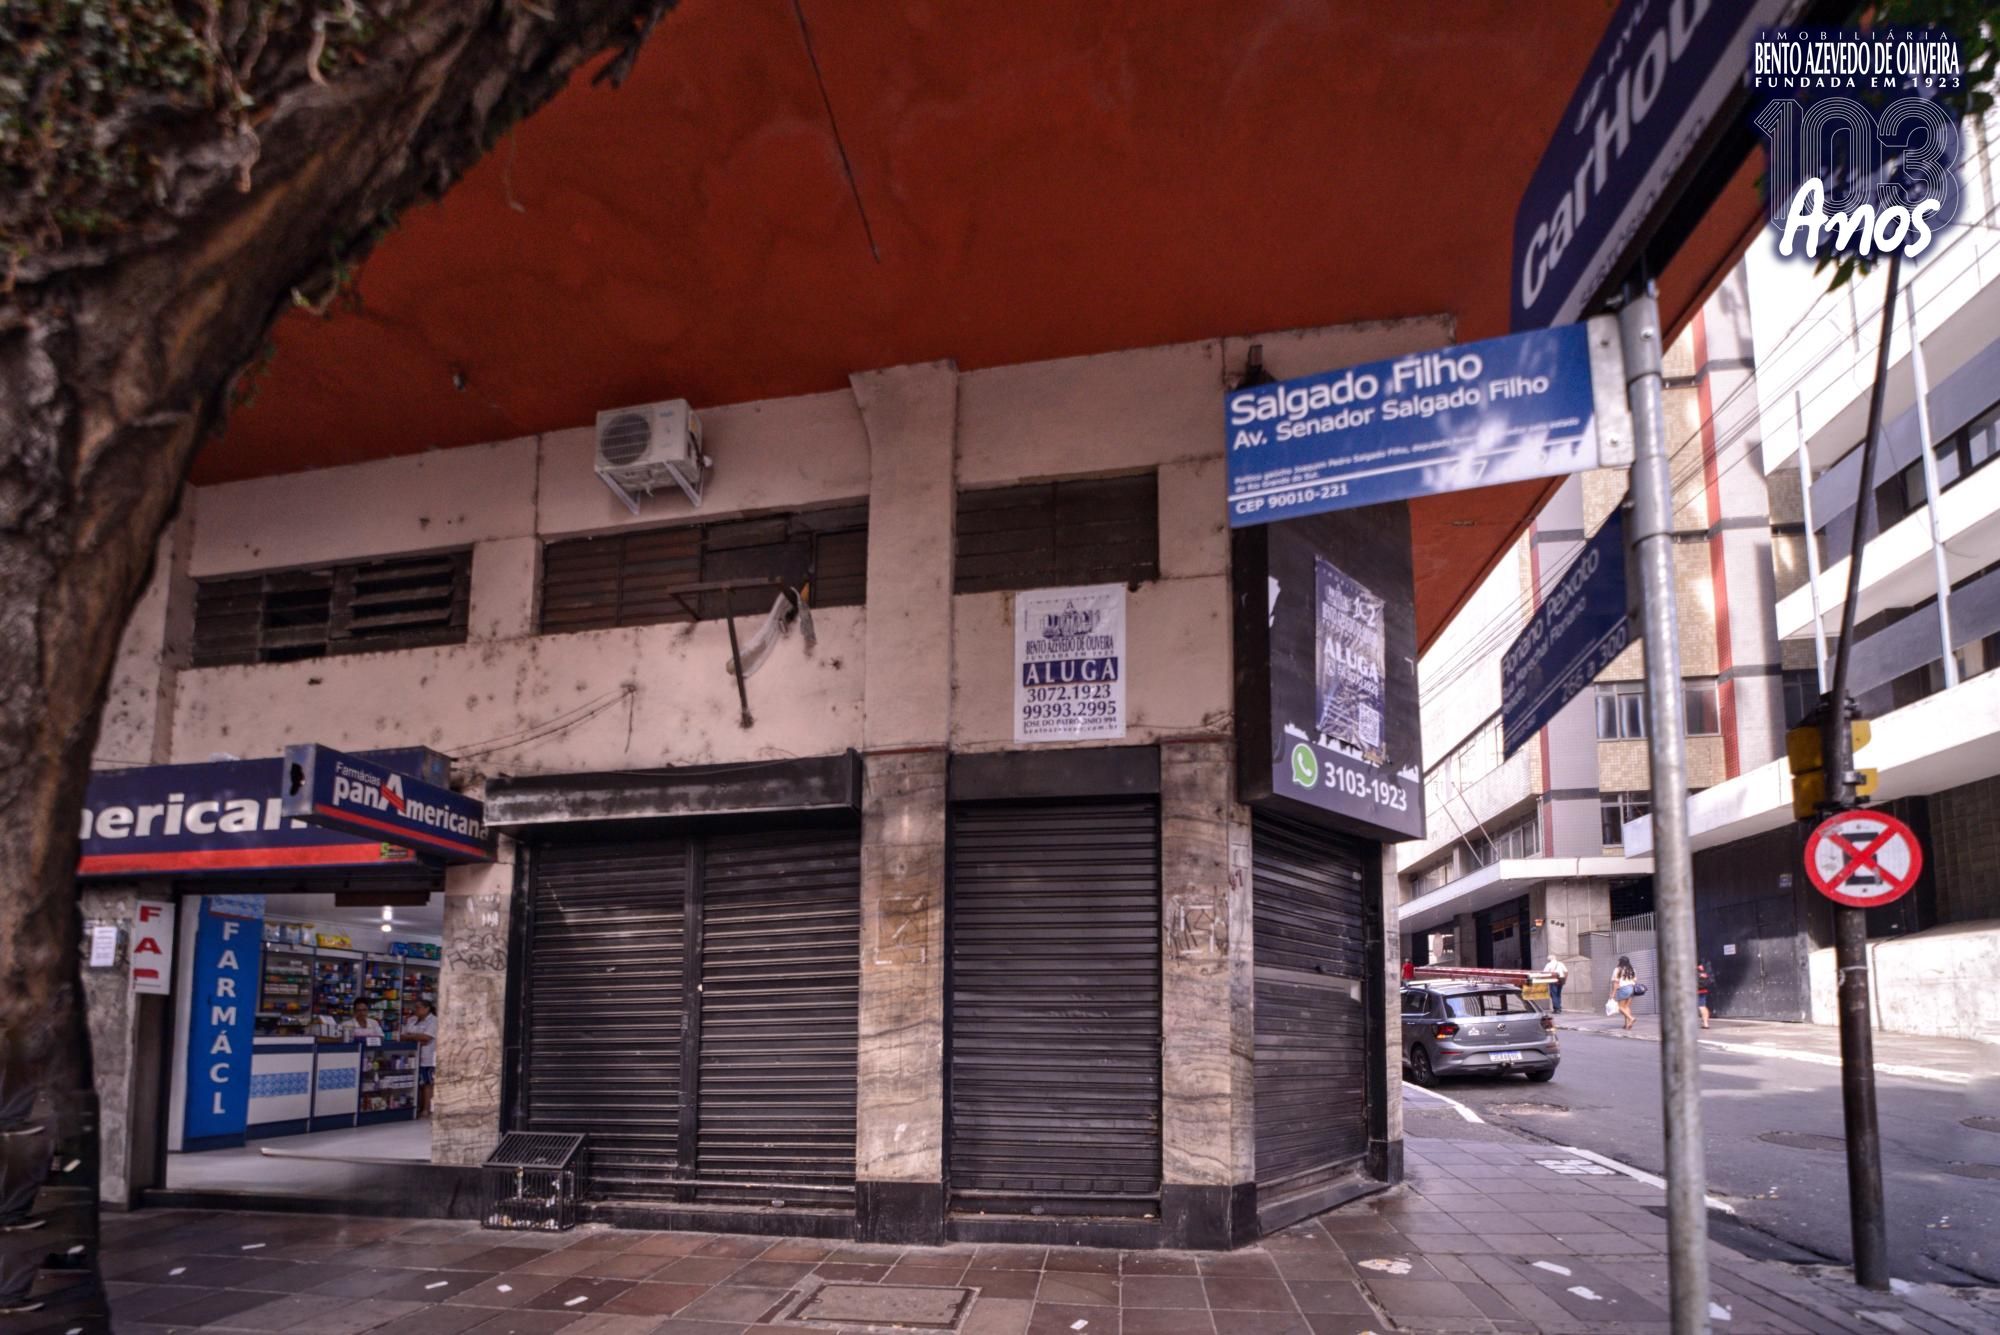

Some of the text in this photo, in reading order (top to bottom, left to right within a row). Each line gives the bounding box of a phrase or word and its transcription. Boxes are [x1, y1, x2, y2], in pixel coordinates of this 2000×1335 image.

[1231, 351, 1483, 426] Salgado Filho
[1233, 376, 1549, 450] Av. Senador Salgado Filho
[1235, 483, 1349, 515] CEP 90010-221
[1546, 548, 1600, 626] Peixoto
[1323, 636, 1379, 682] ALUGA
[1599, 625, 1626, 667] 300
[1026, 658, 1116, 685] ALUGA
[1023, 701, 1117, 719] 99393.2995
[1027, 684, 1111, 703] 3072.1923
[336, 761, 381, 786] Farmácias
[1324, 762, 1407, 811] 3103-1923
